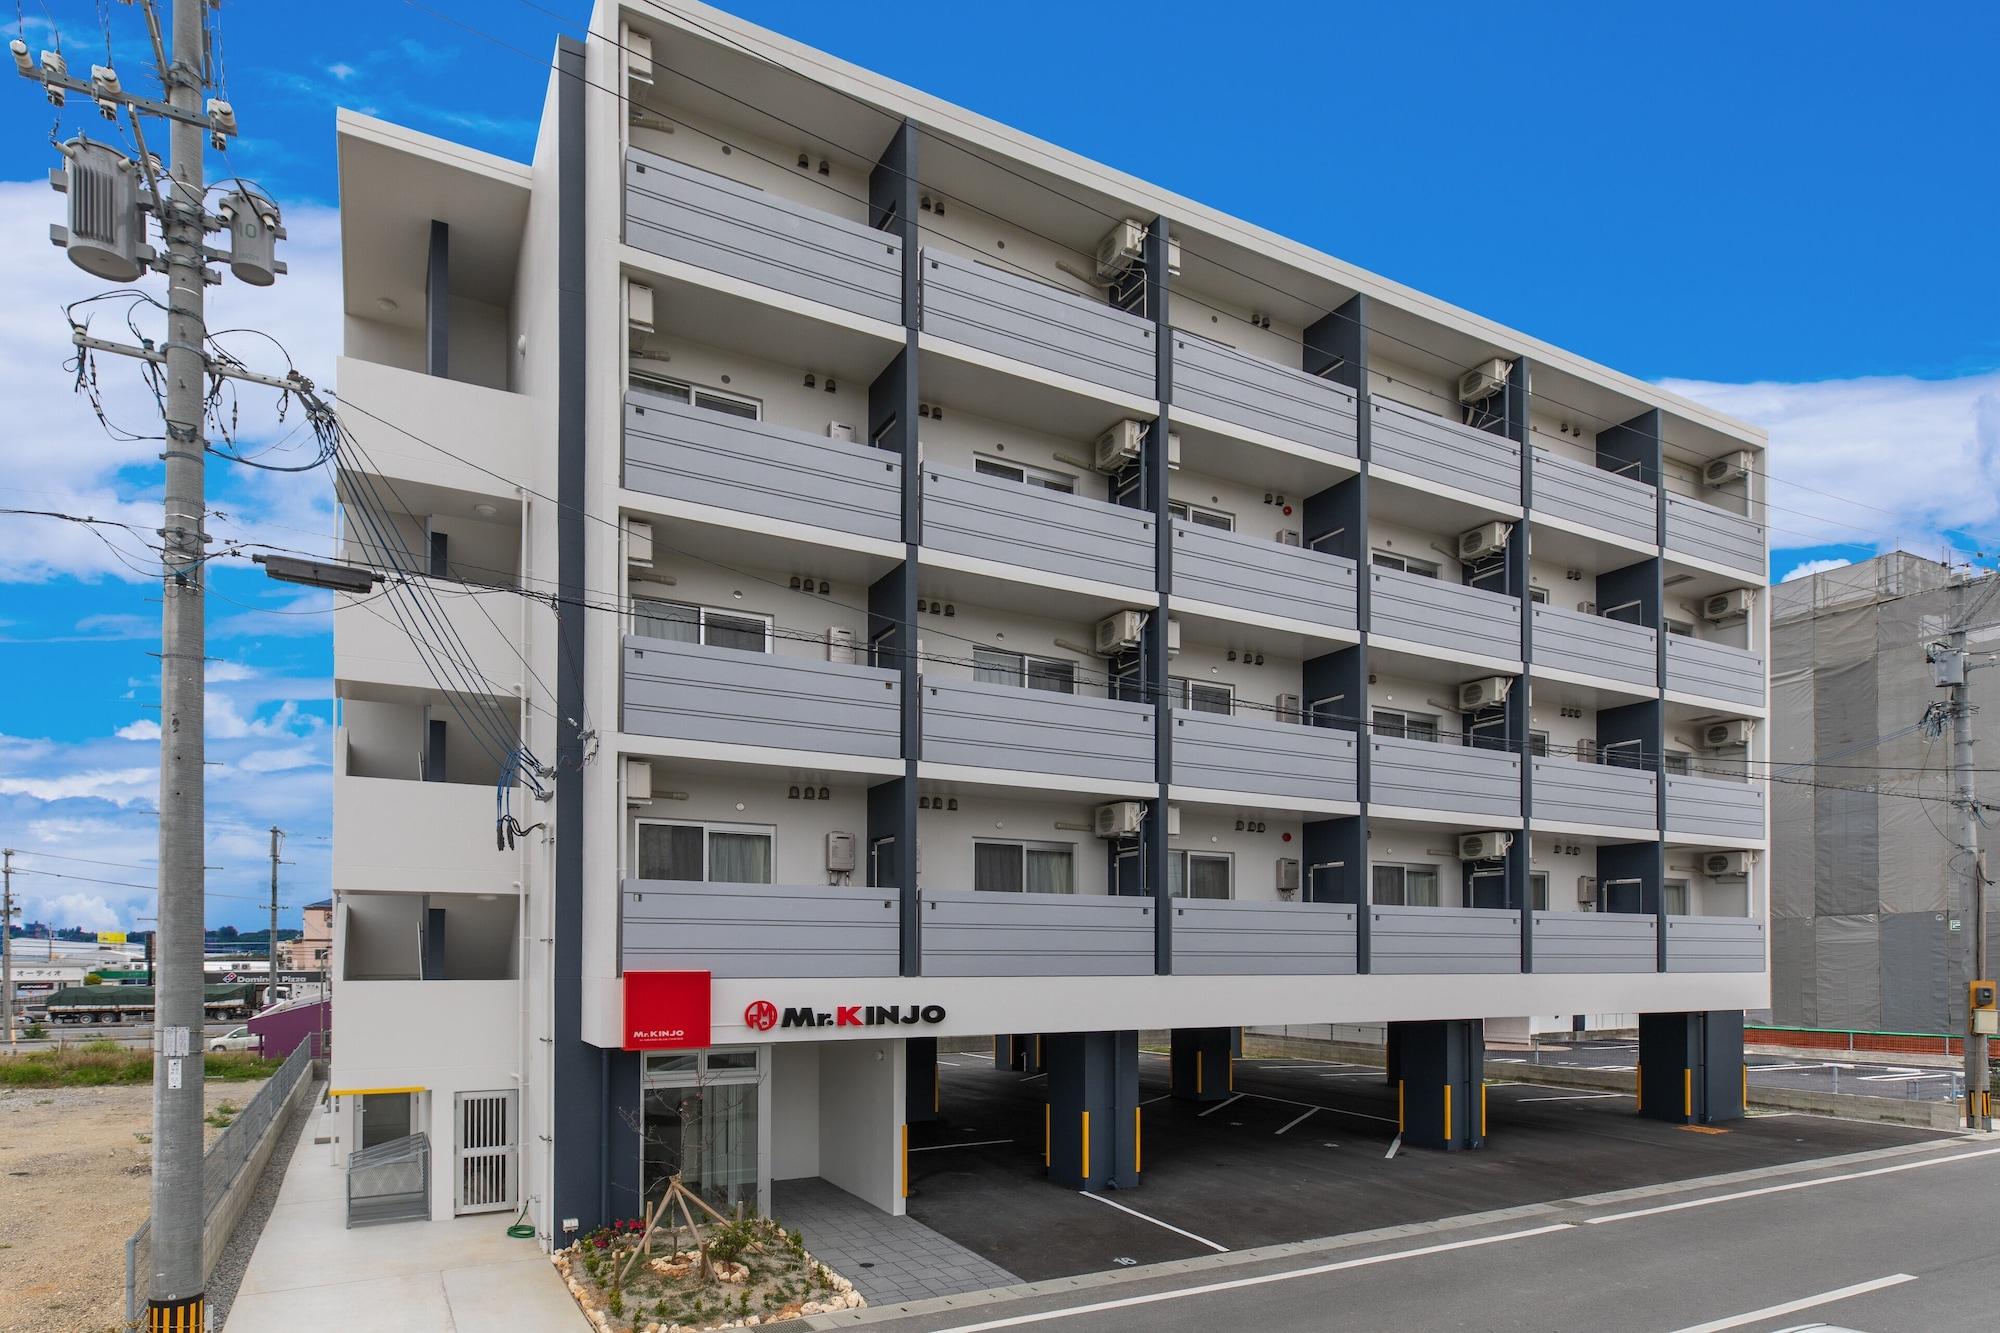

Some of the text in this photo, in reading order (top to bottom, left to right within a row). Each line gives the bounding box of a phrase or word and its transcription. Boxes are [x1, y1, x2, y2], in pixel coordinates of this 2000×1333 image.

[281, 975, 307, 983] Pizza
[781, 1004, 946, 1028] Mr.KINJO
[633, 1029, 685, 1038] Mr.KINJO
